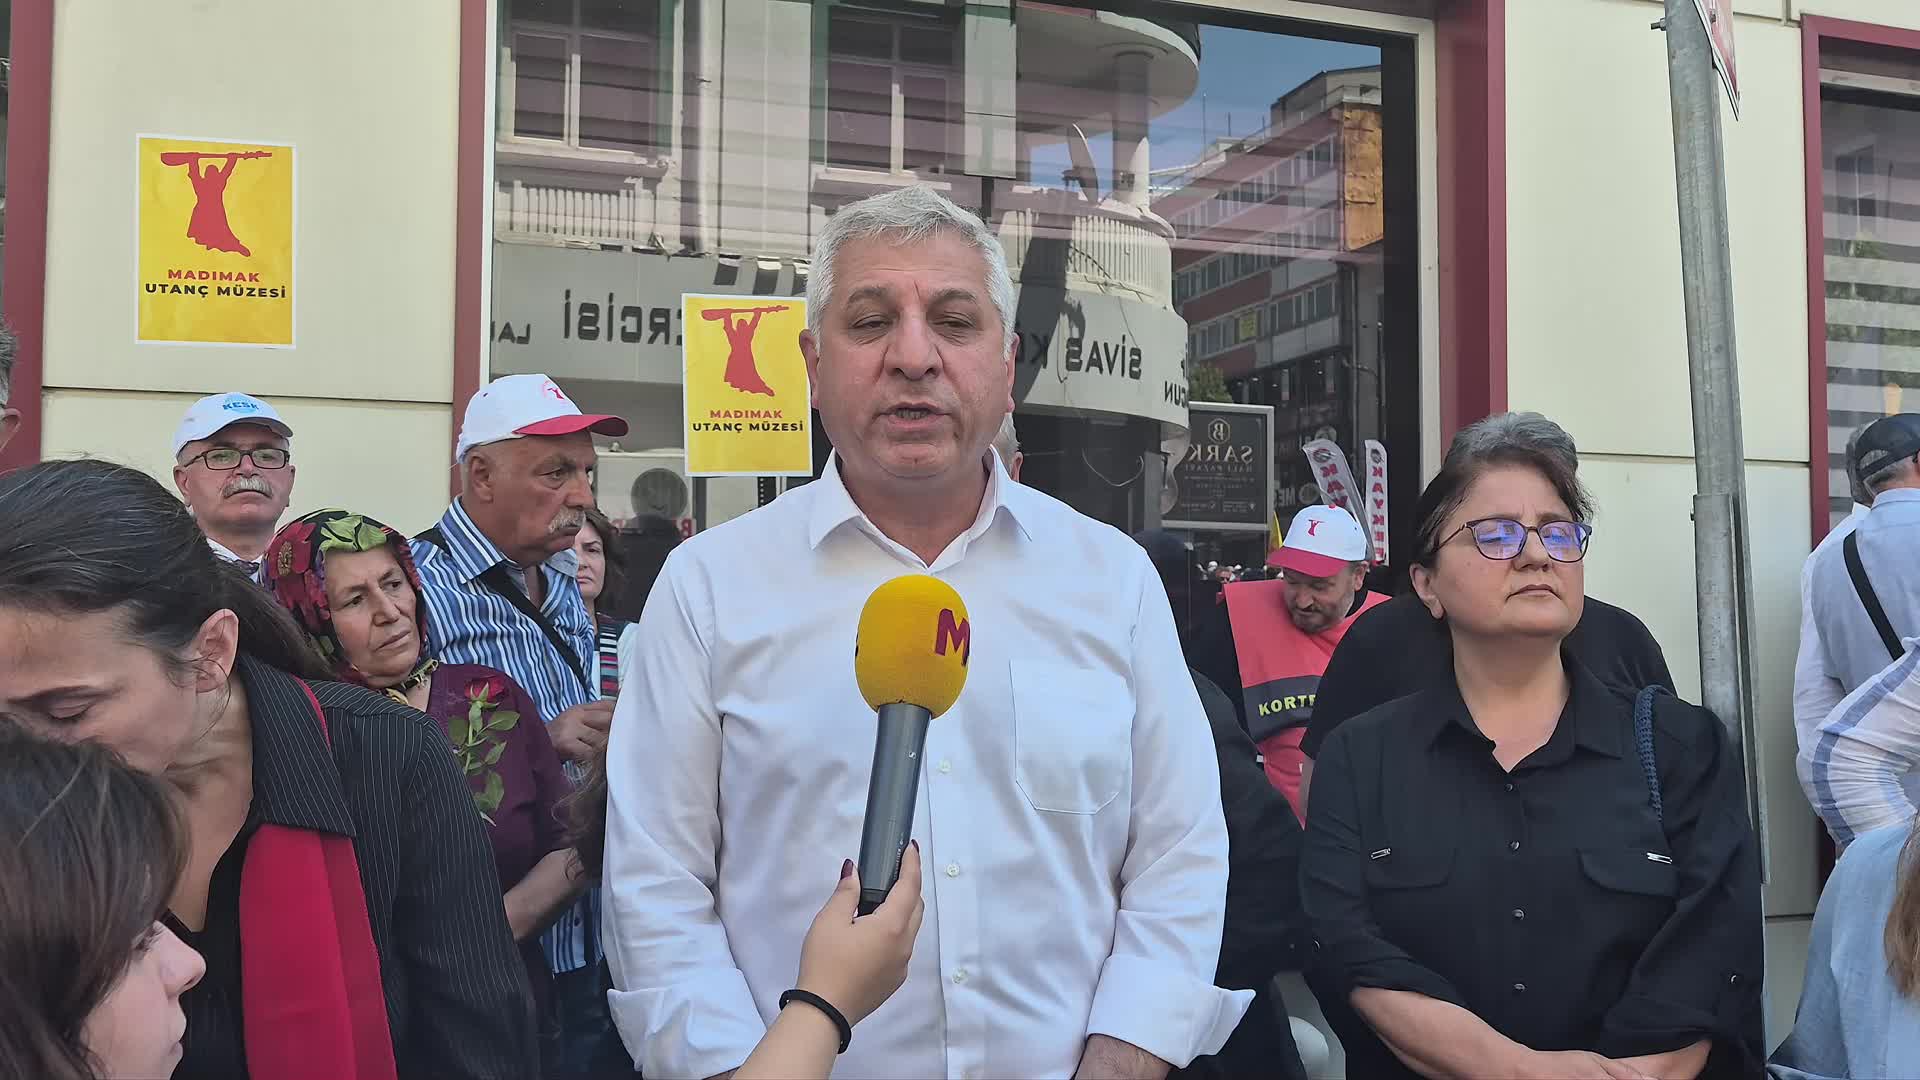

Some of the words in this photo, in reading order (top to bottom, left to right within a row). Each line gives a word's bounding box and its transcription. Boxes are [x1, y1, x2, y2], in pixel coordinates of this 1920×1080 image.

[167, 269, 260, 283] MADIMAK
[145, 283, 209, 298] UTANÇ
[216, 284, 287, 299] MÜZESİ
[709, 410, 784, 419] MADIMAK
[692, 422, 743, 433] UTANÇ
[748, 420, 804, 432] MÜZESİ
[935, 608, 971, 667] M
